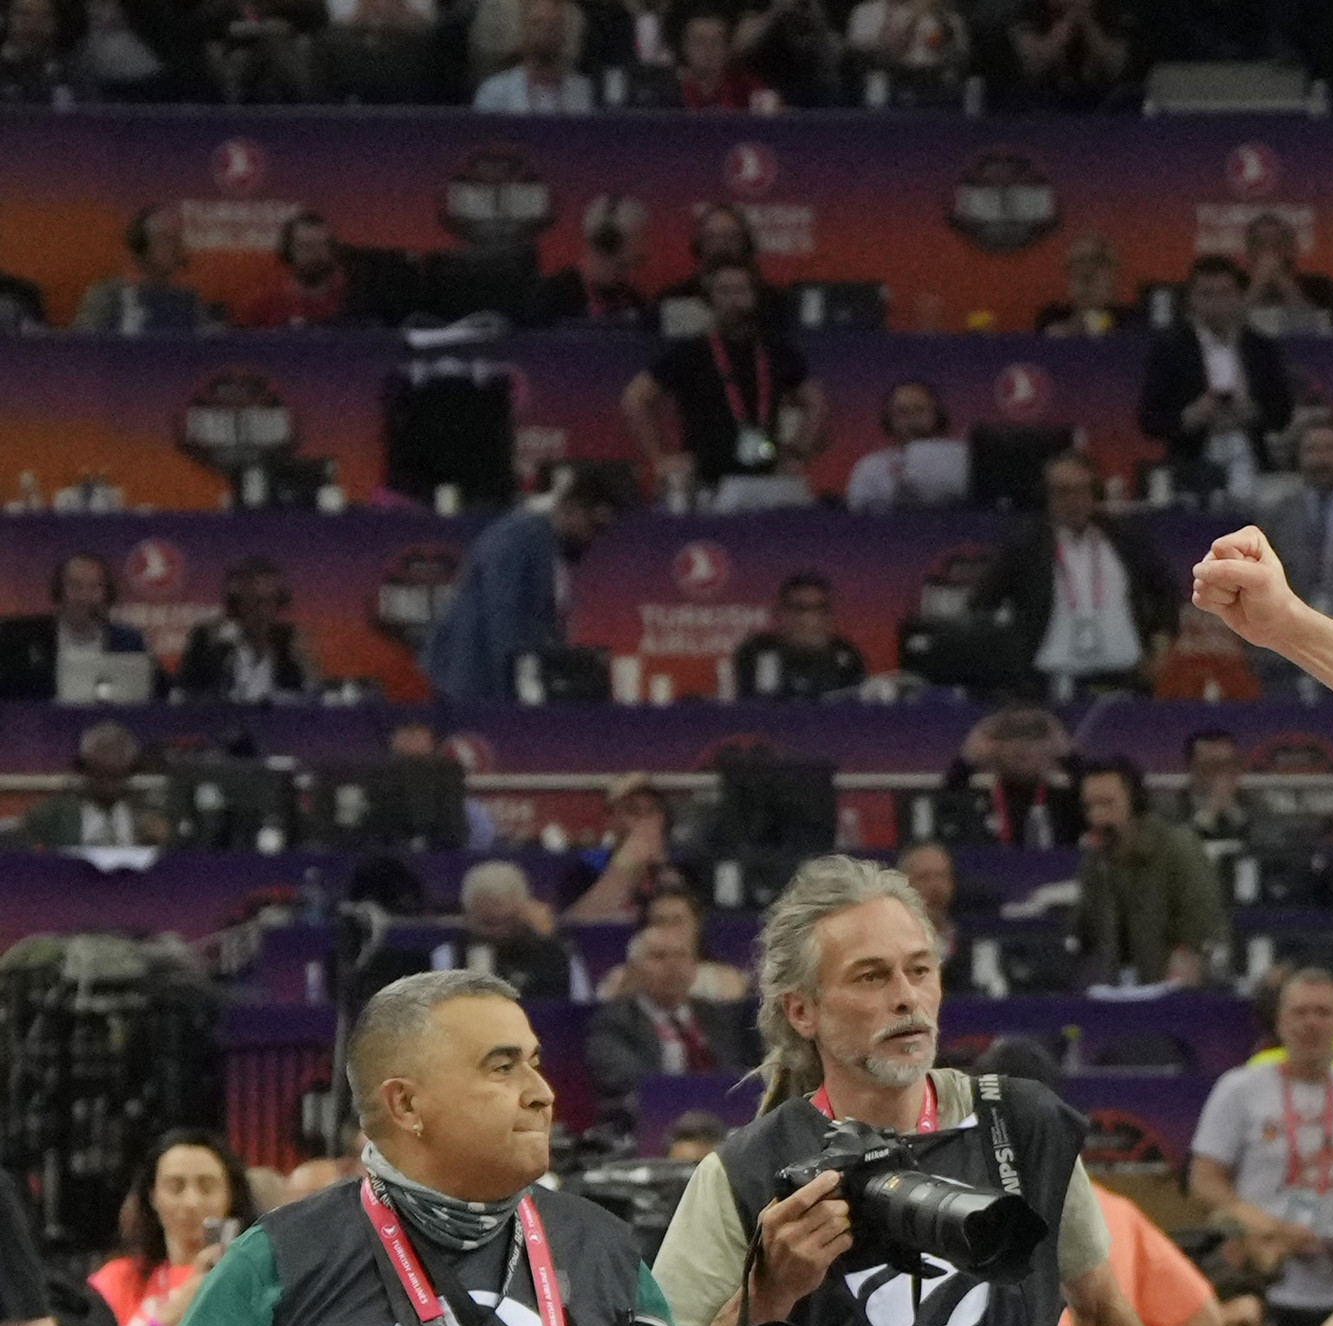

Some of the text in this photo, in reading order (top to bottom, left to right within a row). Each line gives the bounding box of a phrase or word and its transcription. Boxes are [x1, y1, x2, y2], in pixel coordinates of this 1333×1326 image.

[864, 1148, 890, 1162] Nikon
[995, 1147, 1021, 1196] NPS
[392, 1239, 429, 1305] TURKISH AIRLINES
